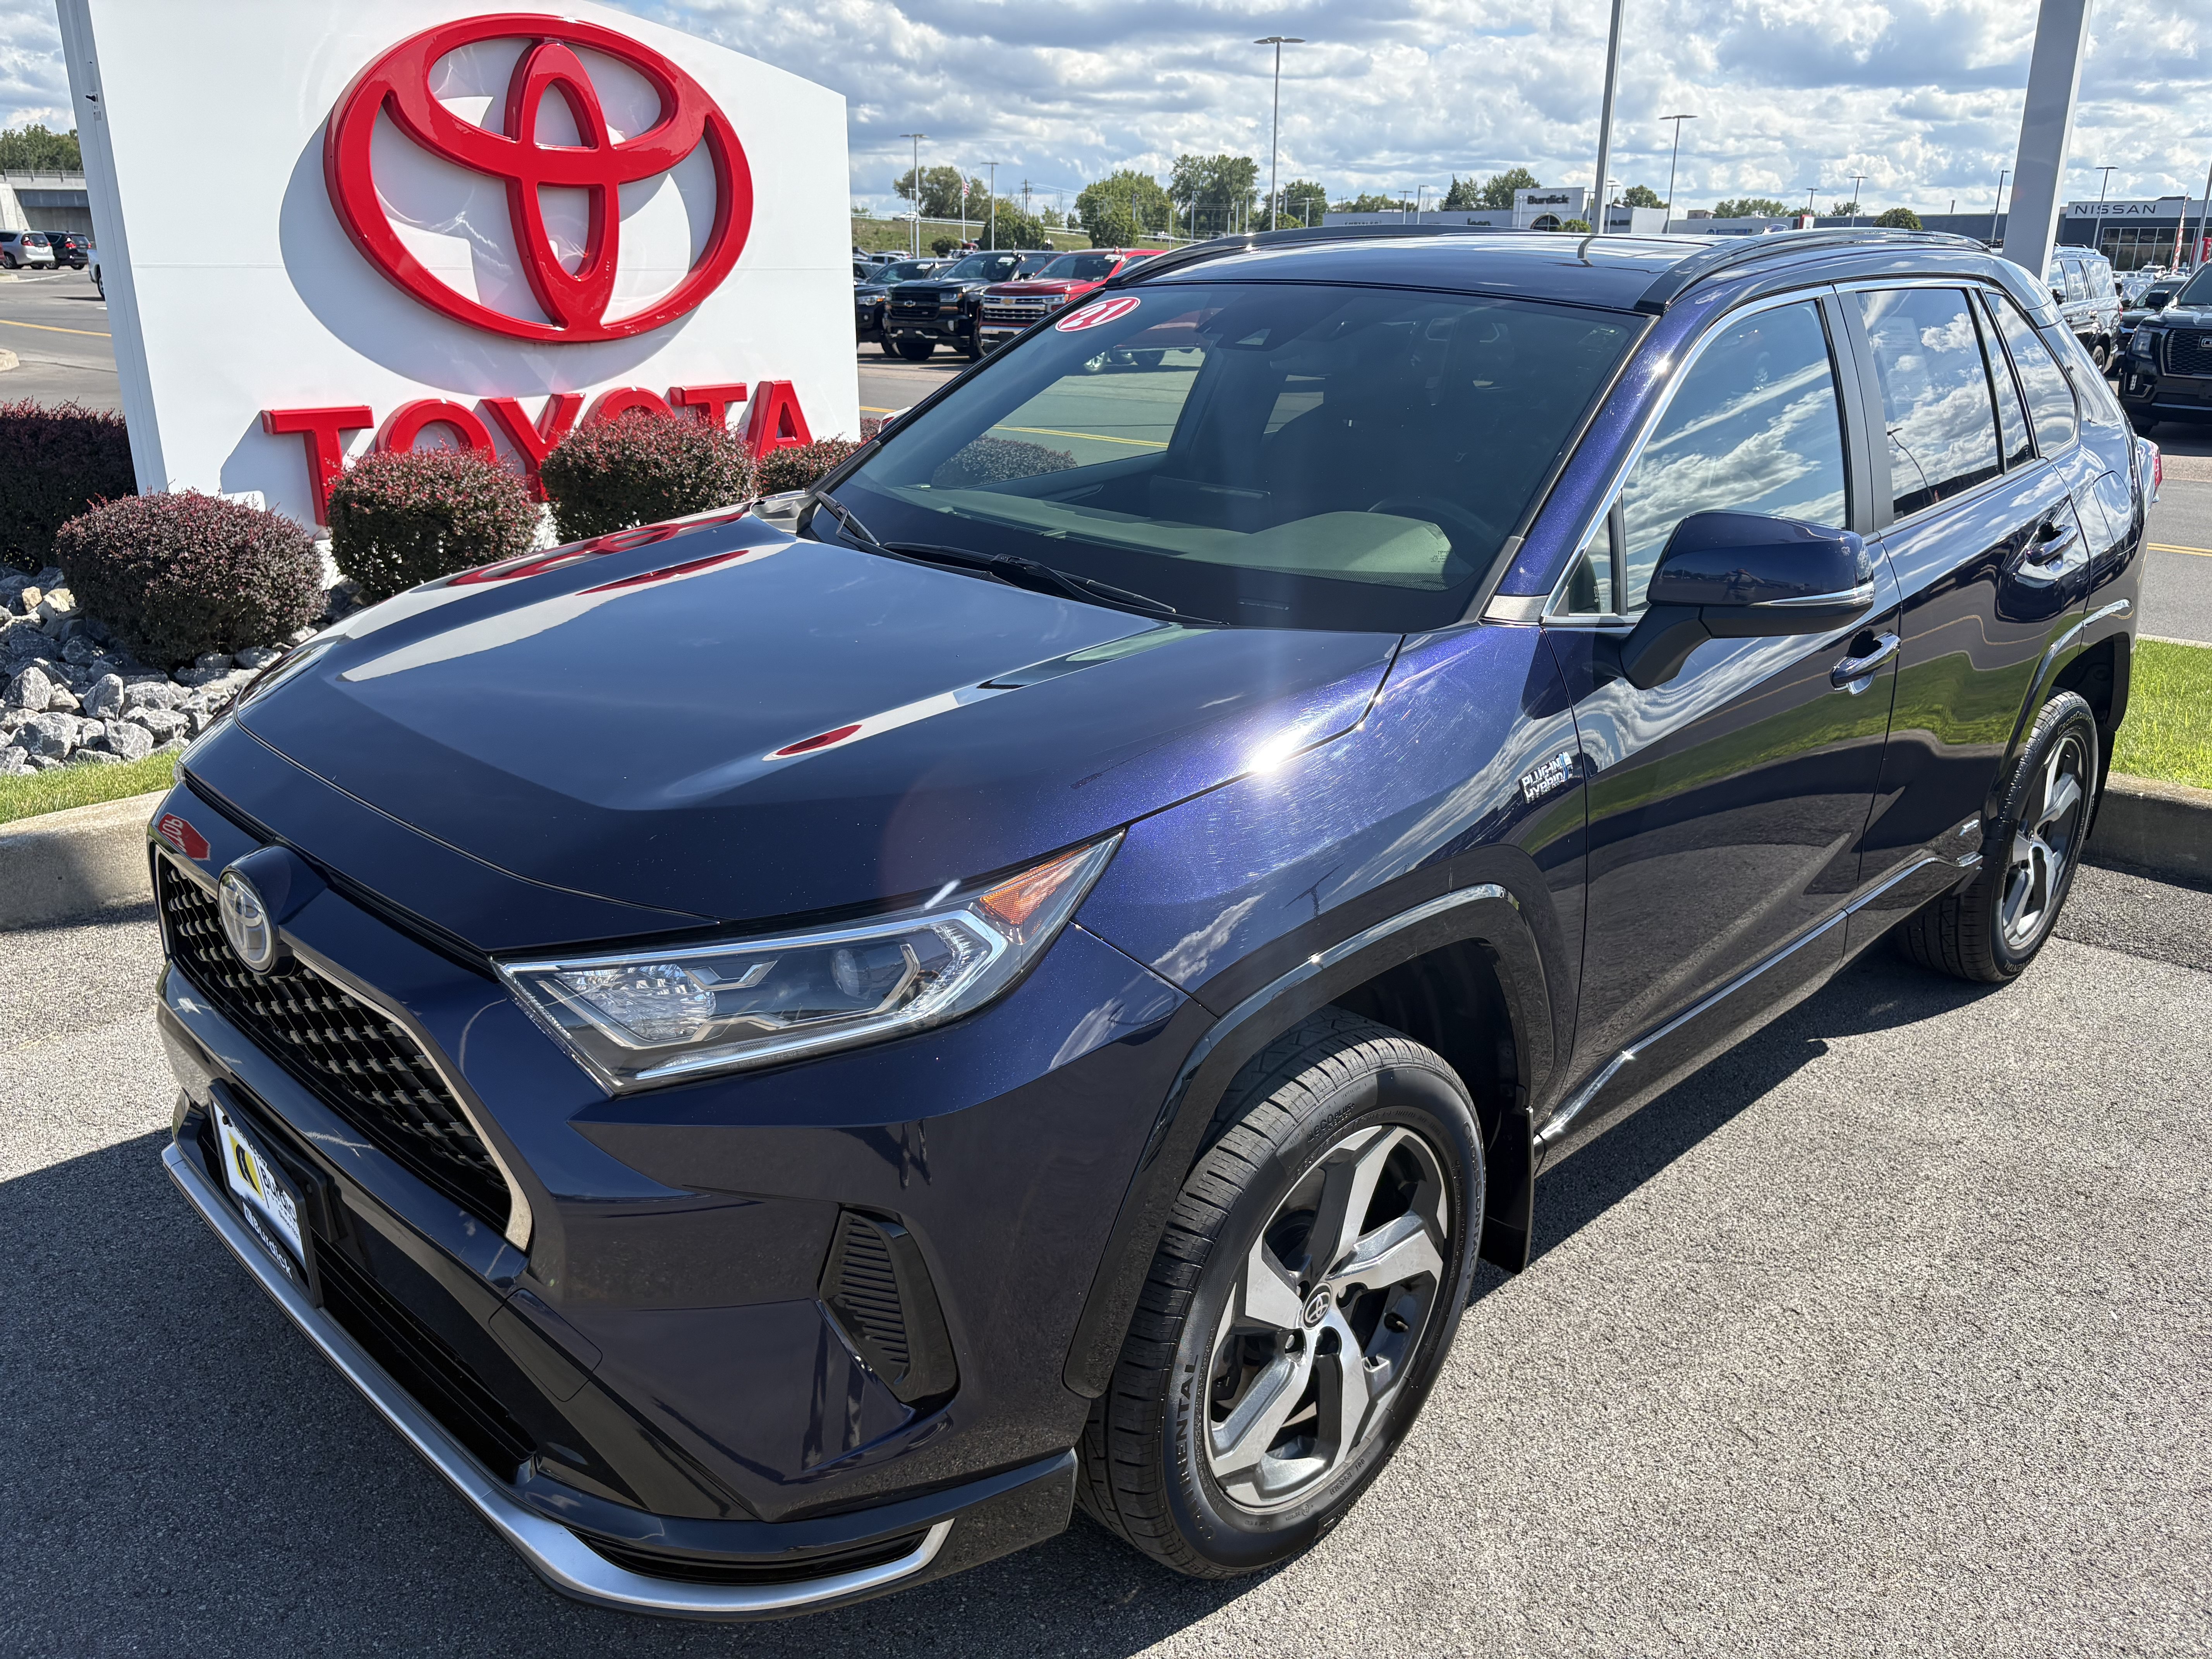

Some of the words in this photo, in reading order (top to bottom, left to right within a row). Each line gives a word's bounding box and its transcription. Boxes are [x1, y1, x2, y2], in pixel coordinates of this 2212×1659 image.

[1527, 195, 1570, 204] Burdick
[2075, 204, 2156, 214] NISSAN
[1060, 299, 1132, 329] 21
[261, 380, 814, 527] TOYTA
[1522, 757, 1563, 787] PLUG-IN
[252, 1214, 292, 1278] Burdick
[1176, 1354, 1215, 1541] CONTINENTAL
